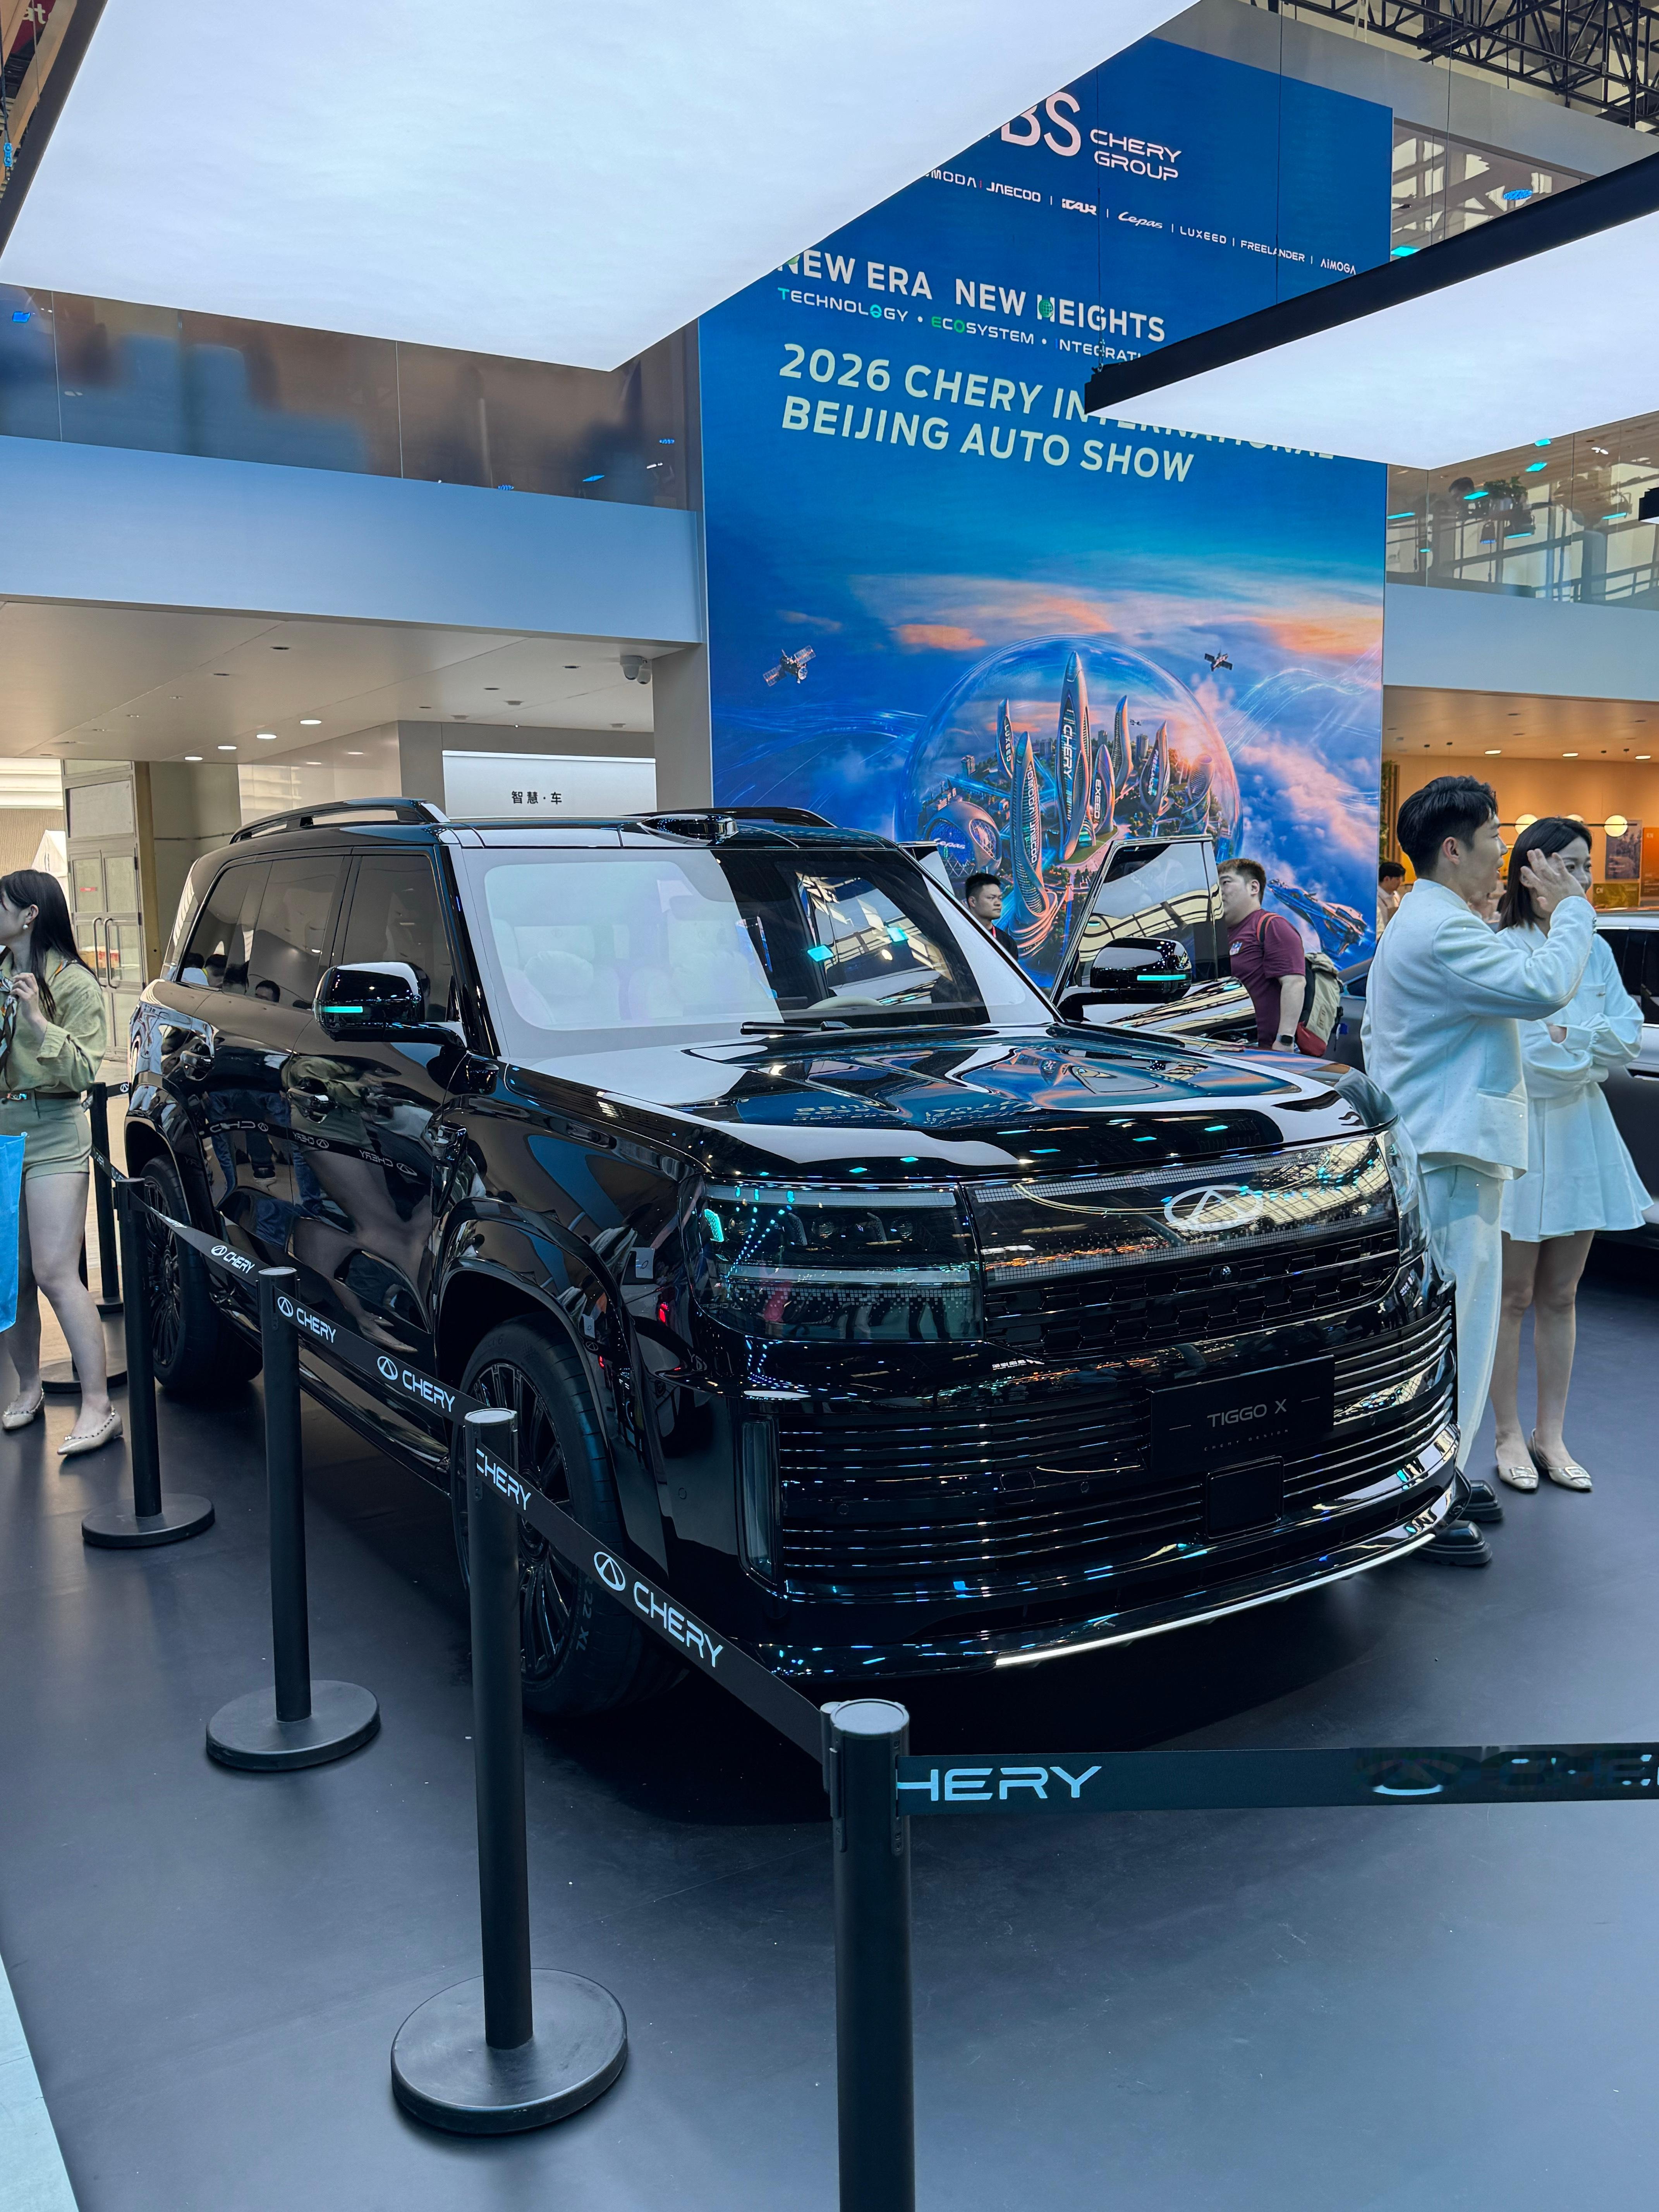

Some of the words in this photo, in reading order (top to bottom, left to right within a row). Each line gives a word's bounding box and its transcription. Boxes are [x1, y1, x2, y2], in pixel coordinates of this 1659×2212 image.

[1090, 129, 1182, 163] CHERY
[1094, 151, 1178, 180] GROUP
[925, 169, 976, 188] MODA
[986, 182, 1041, 202] JAECOO
[1118, 211, 1163, 229] Lepas
[1180, 226, 1226, 244] LUXEED
[1241, 240, 1305, 262] FREELANDER
[778, 287, 908, 322] TECHNOLOGY
[932, 316, 1034, 344] ECOSYSTEM
[867, 261, 932, 299] ERA
[955, 278, 1026, 316] NEW
[1037, 294, 1165, 342] HEIGHTS
[780, 343, 890, 392] 2026
[905, 364, 1043, 414] CHERY
[782, 396, 949, 450] BEIJING
[959, 423, 1069, 466] AUTO
[1080, 440, 1194, 482] SHOW
[1063, 725, 1072, 780] CHERY
[224, 1251, 255, 1274] CHERY
[296, 1307, 336, 1343] CHERY
[402, 1370, 455, 1412] CHERY
[1207, 1404, 1267, 1427] TIGGO
[1275, 1399, 1287, 1414] X
[583, 1590, 593, 1618] 22
[634, 1582, 723, 1668] CHERY
[576, 1626, 589, 1651] XL
